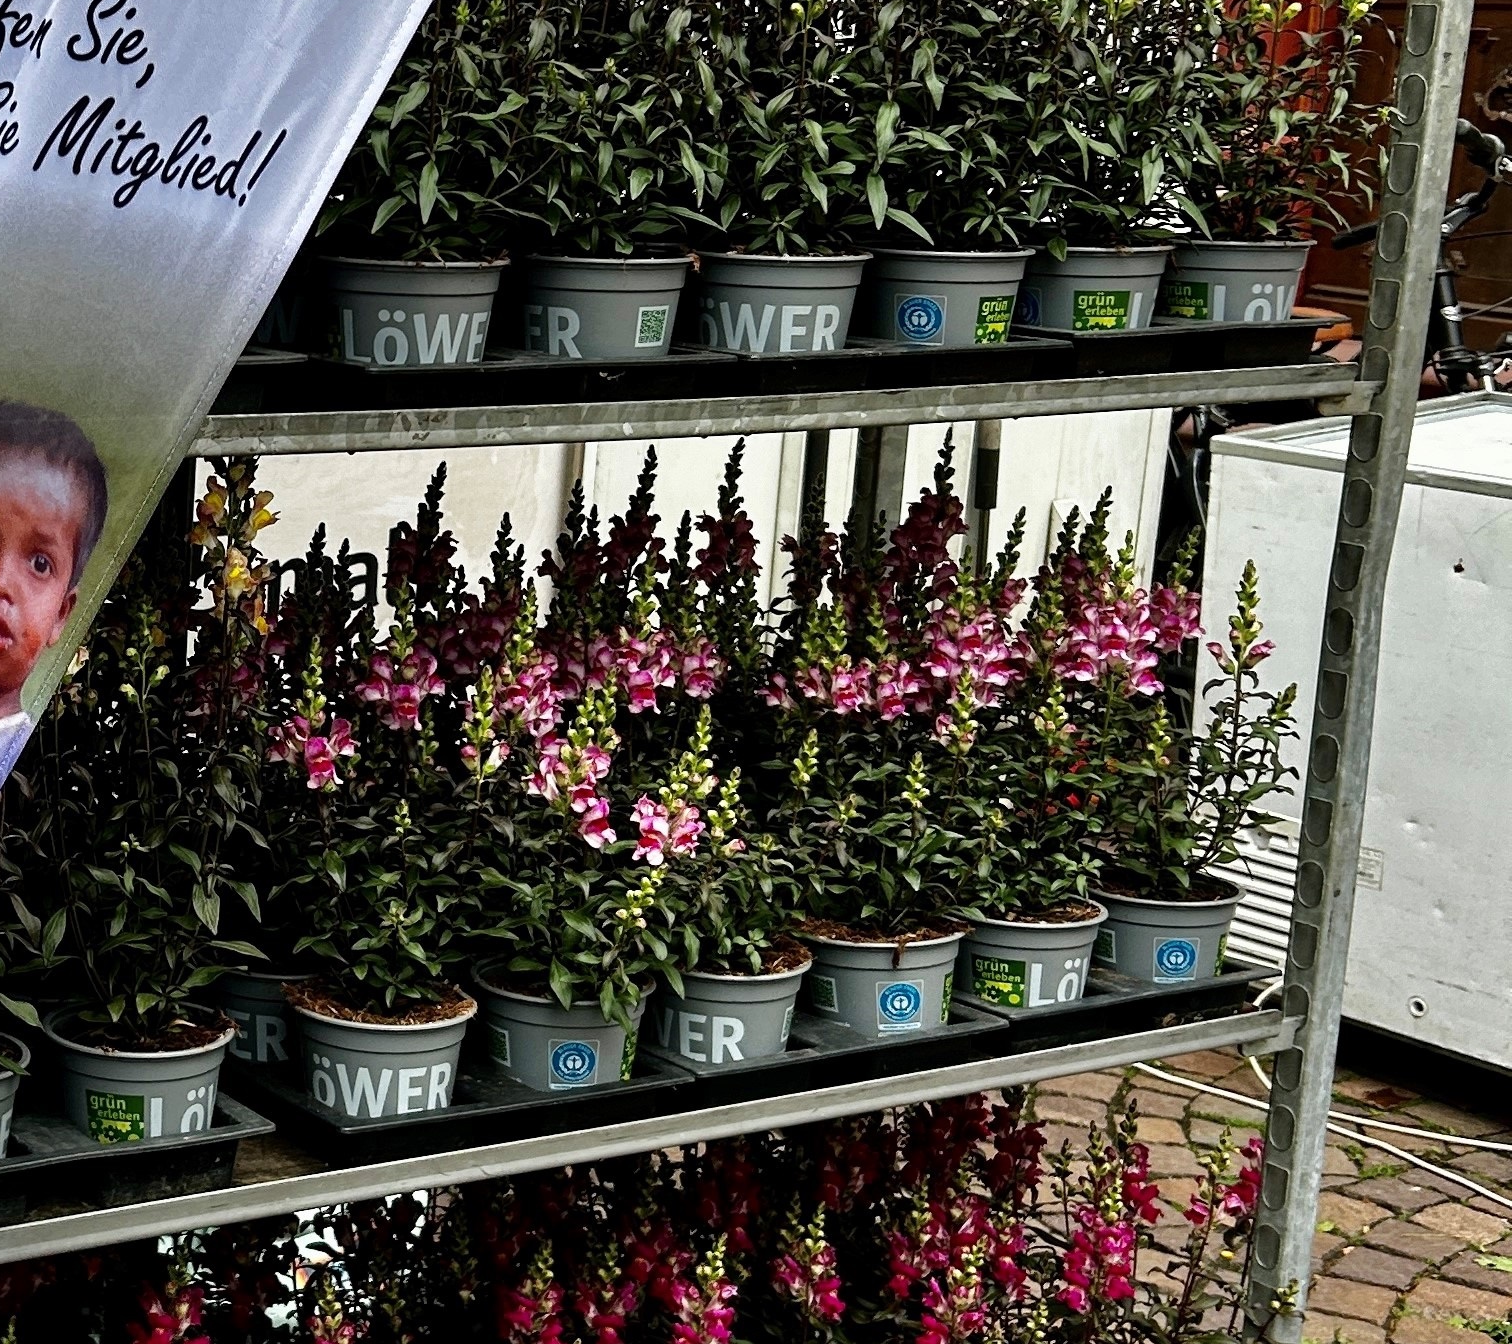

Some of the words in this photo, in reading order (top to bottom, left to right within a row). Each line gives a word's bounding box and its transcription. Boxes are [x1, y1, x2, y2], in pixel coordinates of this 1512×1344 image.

[33, 95, 288, 209] Mitglied!
[980, 297, 1008, 316] grün
[1077, 291, 1116, 309] grün
[1085, 306, 1125, 317] erleben
[975, 958, 1010, 974] grün
[981, 970, 1021, 983] erleben
[89, 1093, 127, 1110] grün
[97, 1109, 141, 1121] erleben
